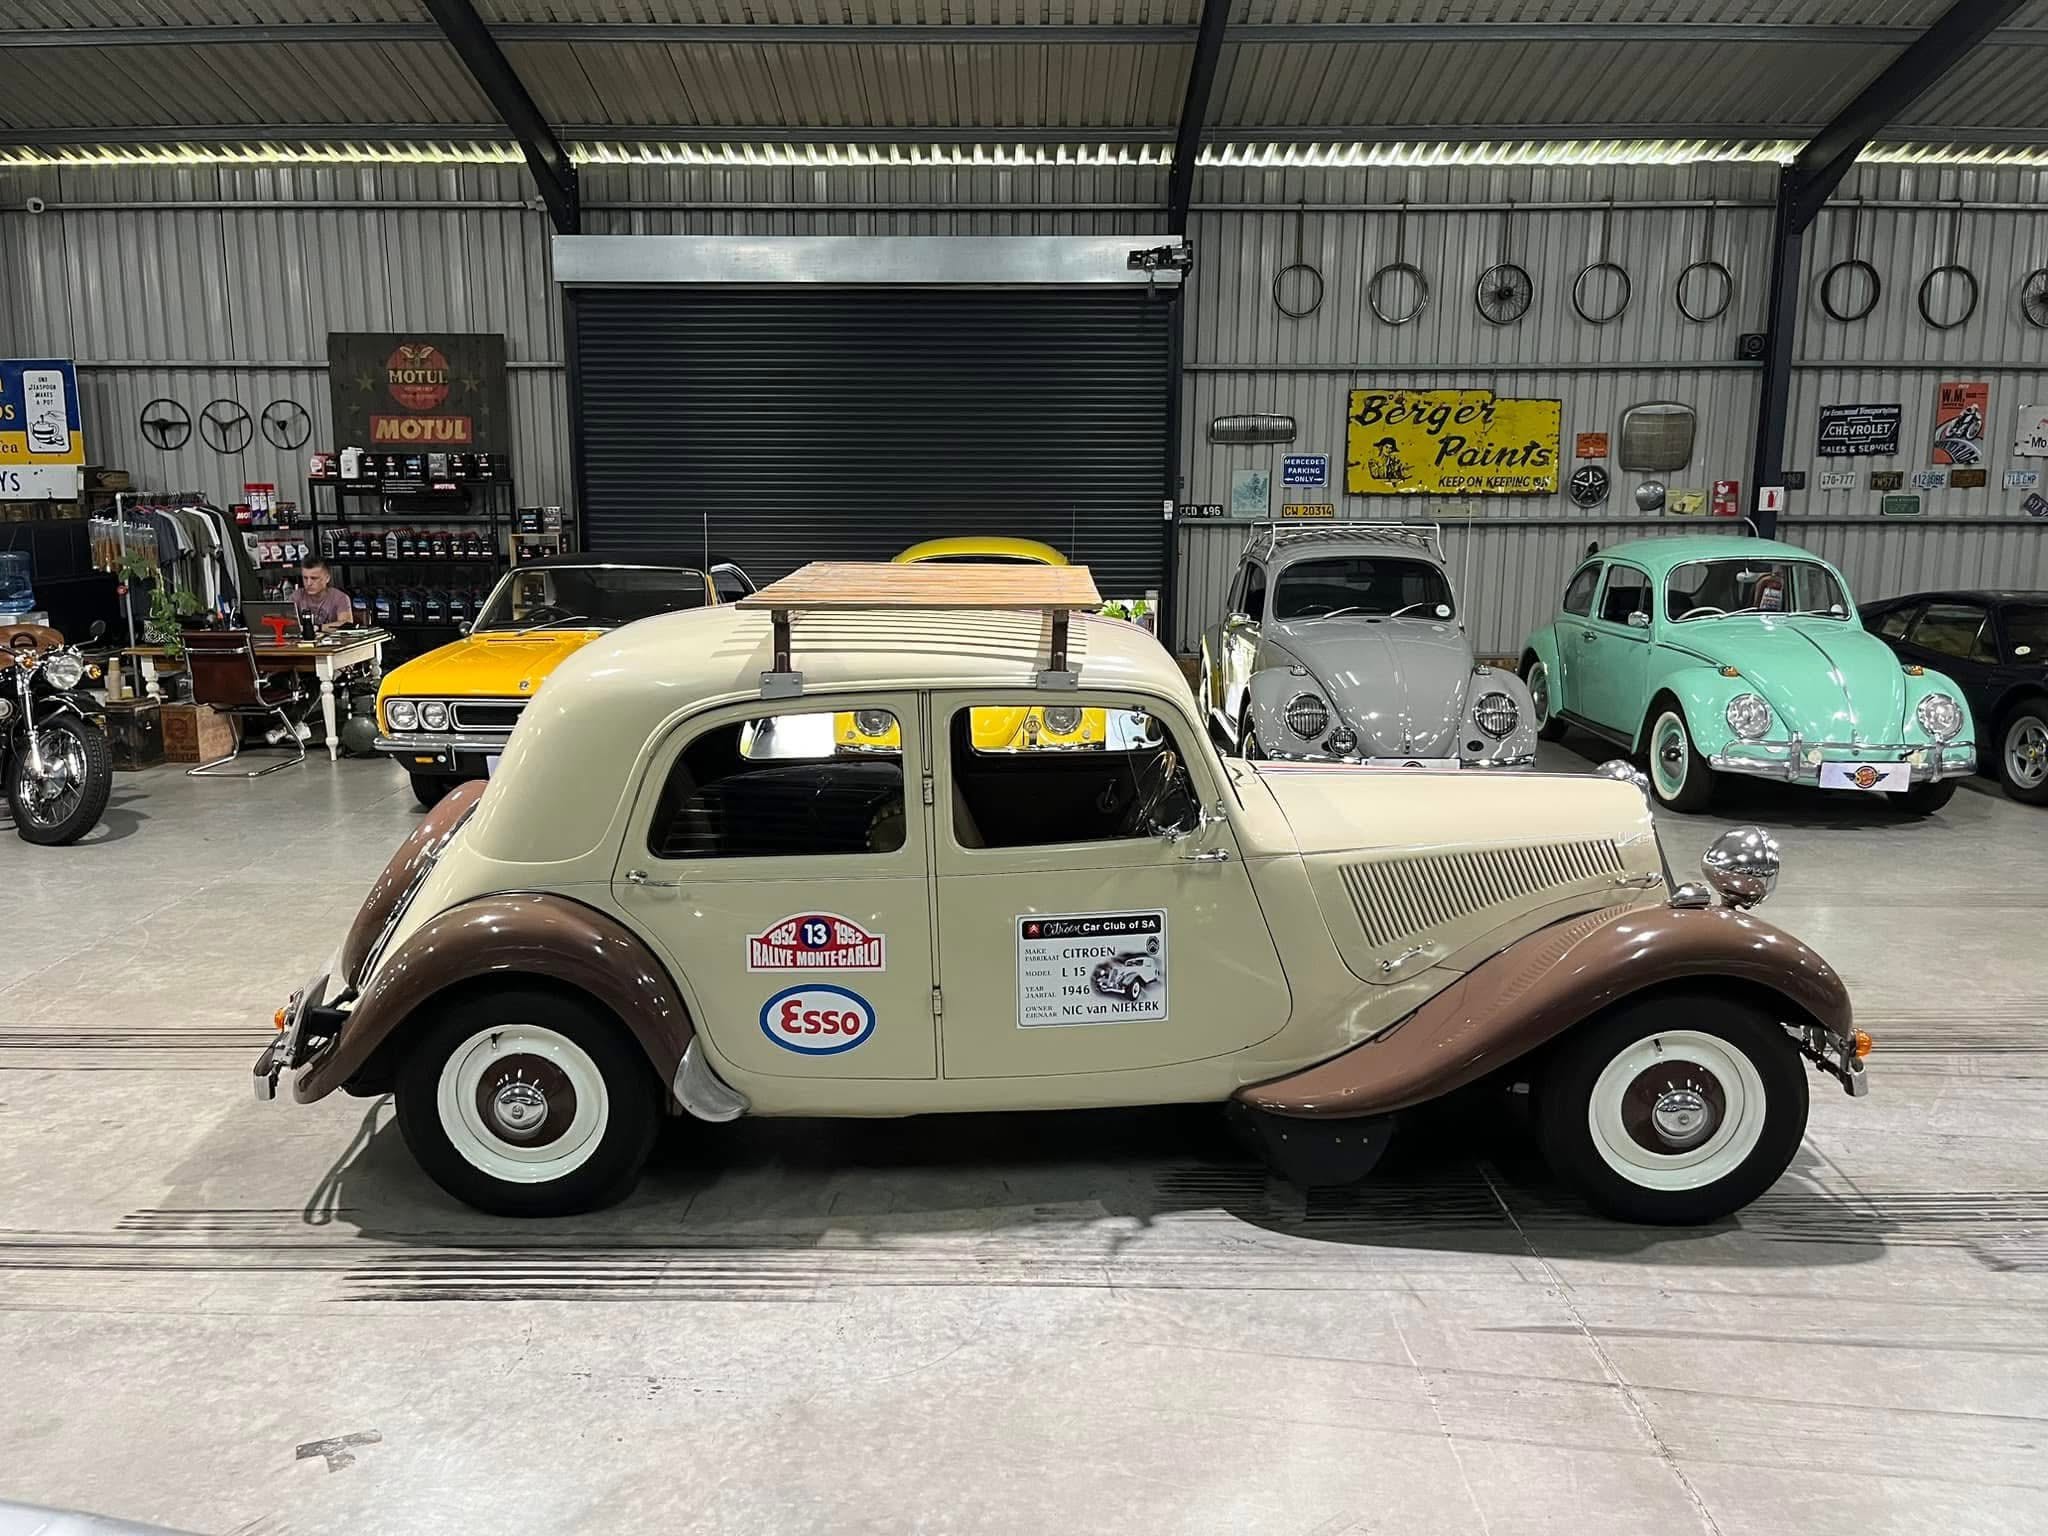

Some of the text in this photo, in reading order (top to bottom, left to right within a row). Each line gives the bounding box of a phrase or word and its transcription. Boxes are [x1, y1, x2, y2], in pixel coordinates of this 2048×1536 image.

[389, 369, 448, 384] MOTUL
[1354, 395, 1496, 435] Berger
[375, 418, 467, 440] MOTUL
[1829, 424, 1889, 436] CHEVROLET
[1435, 435, 1553, 468] Paints
[1821, 445, 1847, 454] SALES
[1859, 443, 1895, 453] SERVICE
[1288, 467, 1320, 475] PARKING
[1438, 476, 1465, 488] KEEP
[1466, 476, 1483, 488] ON
[1486, 476, 1531, 488] KEEPING
[1203, 506, 1221, 516] 496
[1284, 506, 1333, 515] CW 20314
[1082, 922, 1100, 932] Car
[1103, 921, 1125, 931] Club
[1129, 920, 1139, 929] of
[1142, 919, 1156, 929] SA
[768, 921, 864, 945] 1952 13 1952
[752, 940, 794, 967] RALLYE
[1062, 967, 1086, 977] L 15
[1062, 985, 1090, 996] 1946
[1062, 1001, 1159, 1016] NIC van NIEKERK
